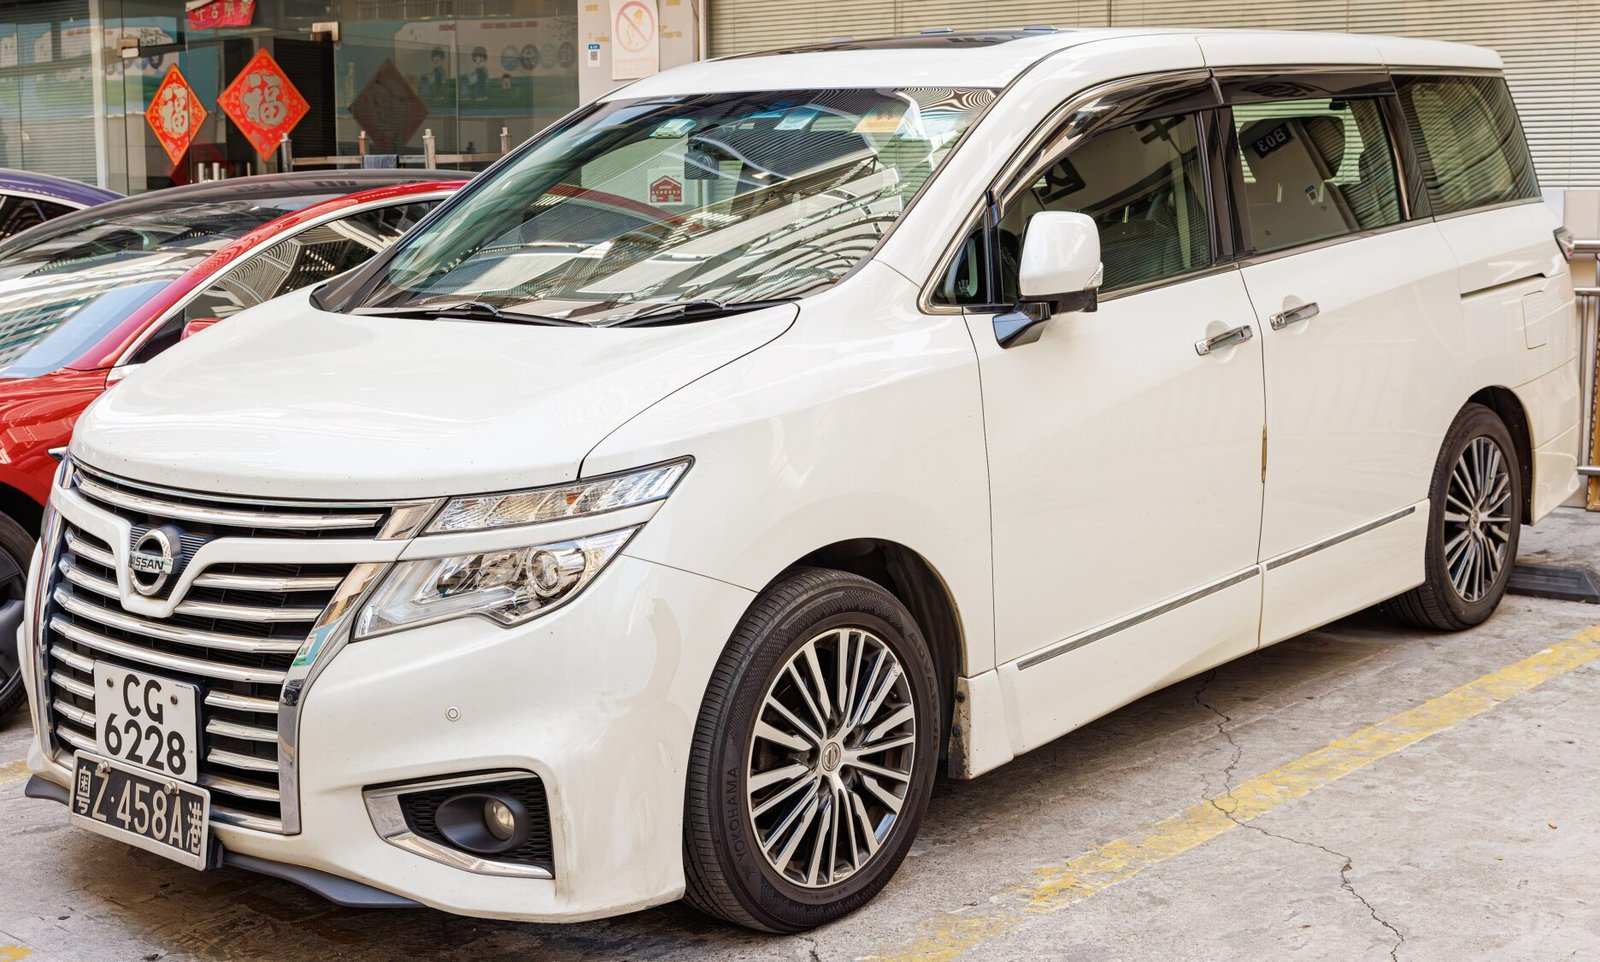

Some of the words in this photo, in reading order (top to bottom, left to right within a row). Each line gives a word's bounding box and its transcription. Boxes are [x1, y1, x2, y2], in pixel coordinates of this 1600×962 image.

[160, 86, 188, 135] 福
[244, 73, 286, 126] 福
[122, 673, 164, 726] CG
[104, 712, 187, 776] 6228
[726, 766, 748, 861] YOKOHAMA
